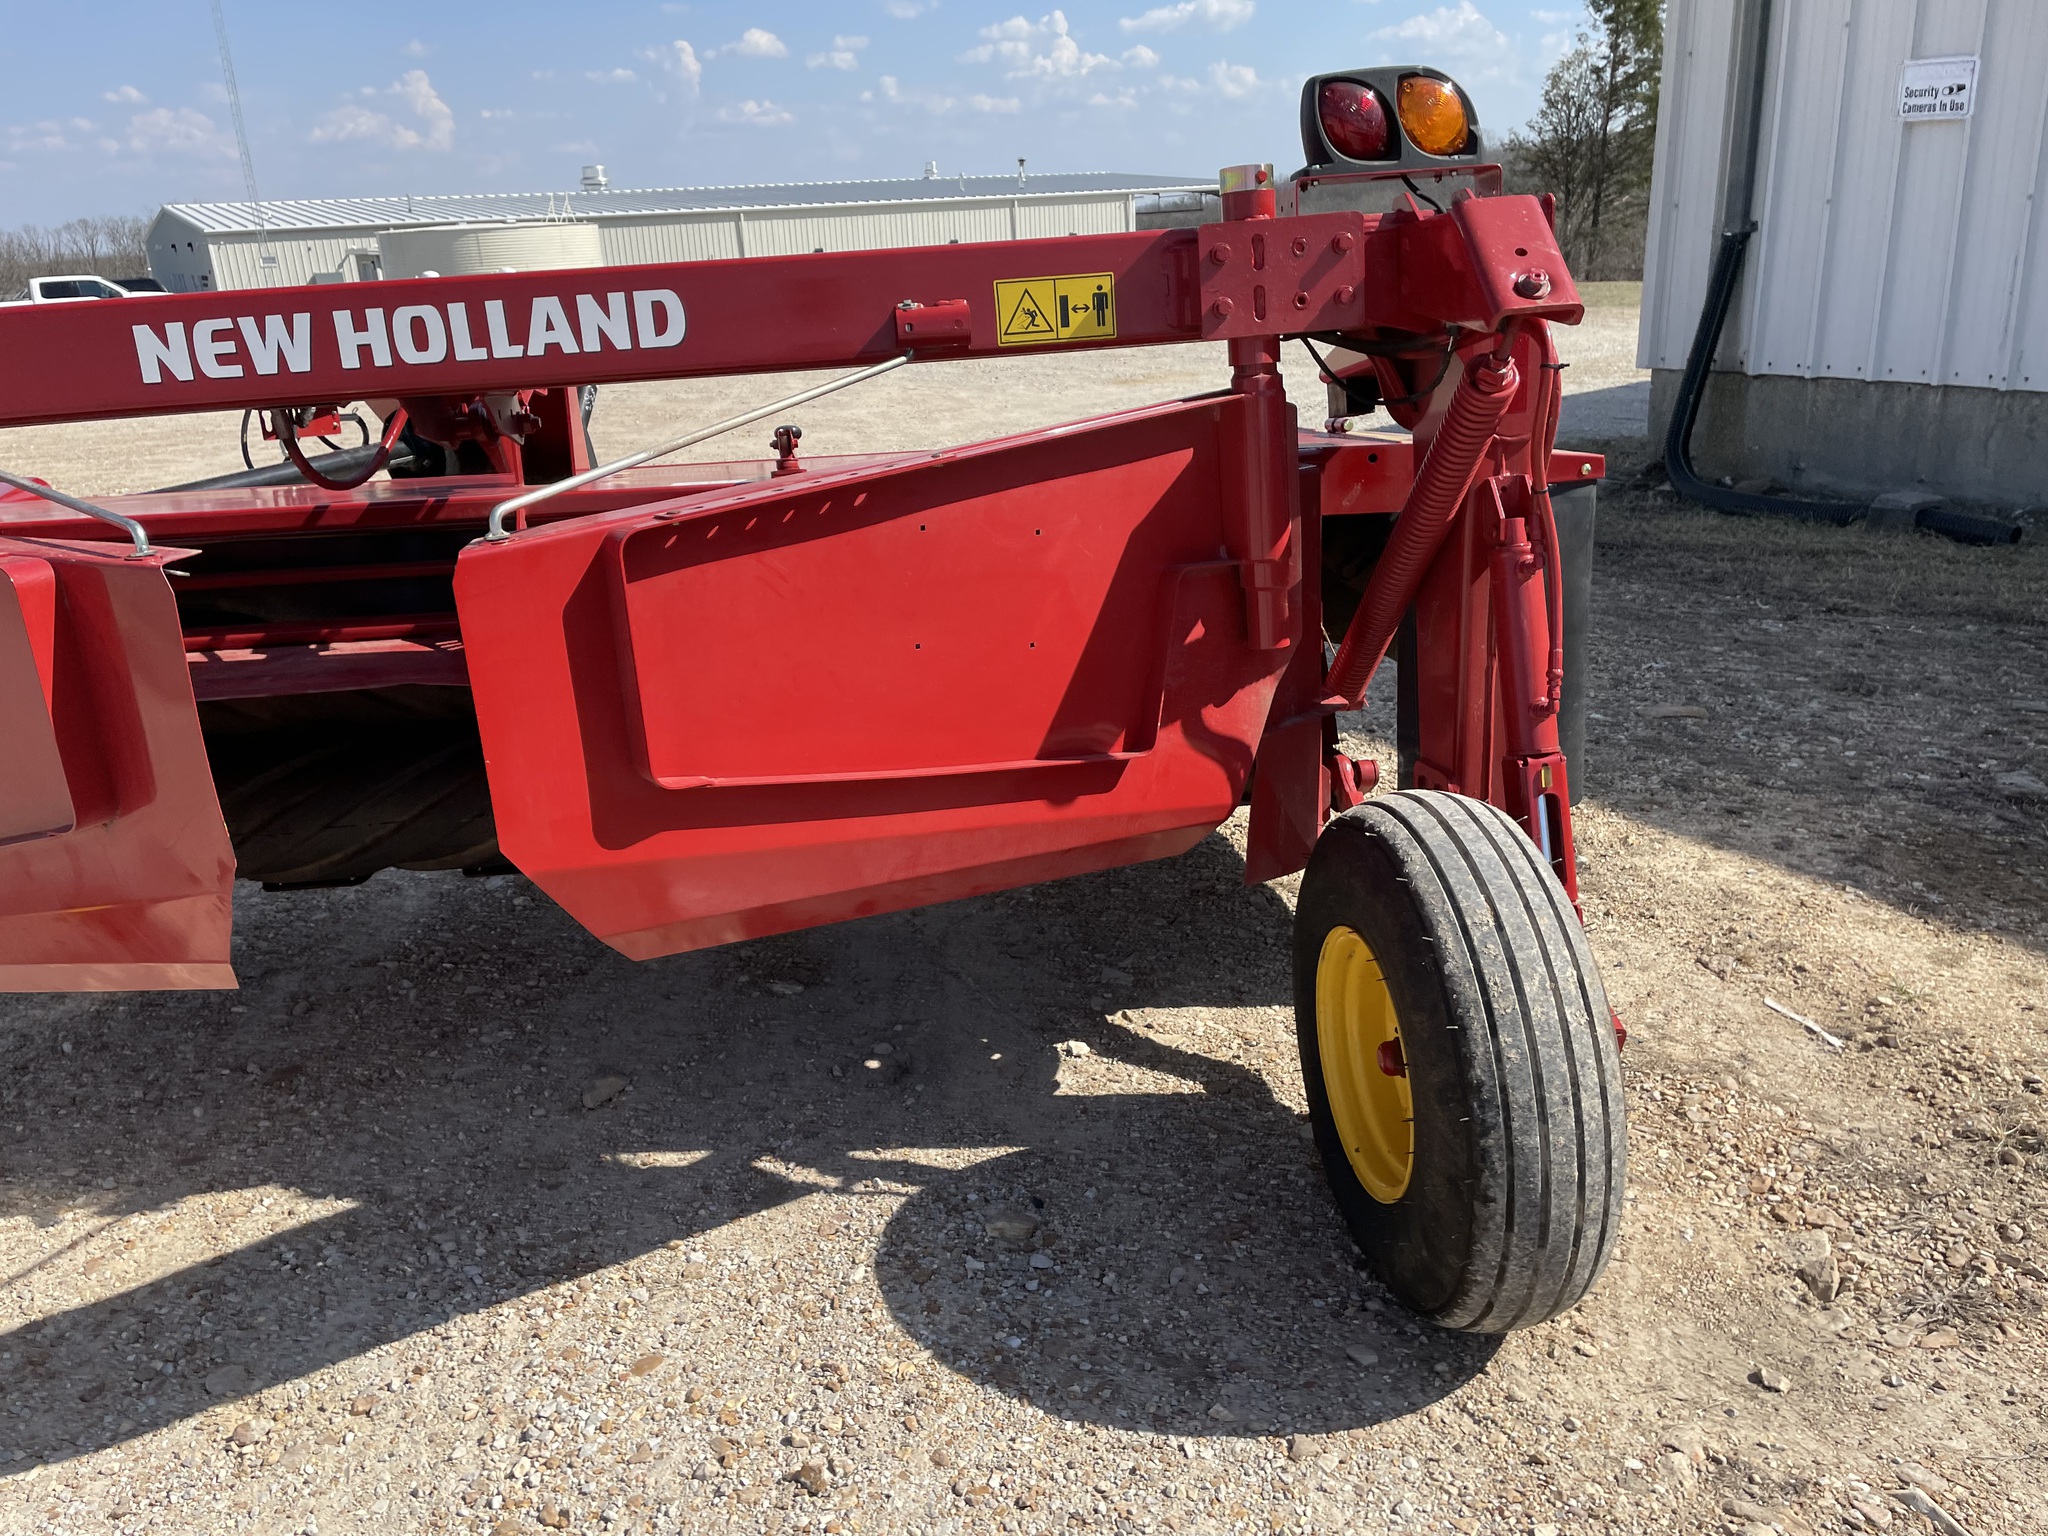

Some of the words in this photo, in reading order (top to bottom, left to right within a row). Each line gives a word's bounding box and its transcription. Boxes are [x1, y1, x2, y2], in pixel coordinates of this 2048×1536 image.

[1904, 85, 1940, 100] Security
[1902, 101, 1937, 114] Cameras
[1939, 100, 1947, 112] In
[1949, 99, 1965, 111] Use
[132, 312, 311, 384] NEW
[333, 289, 687, 369] HOLLAND
